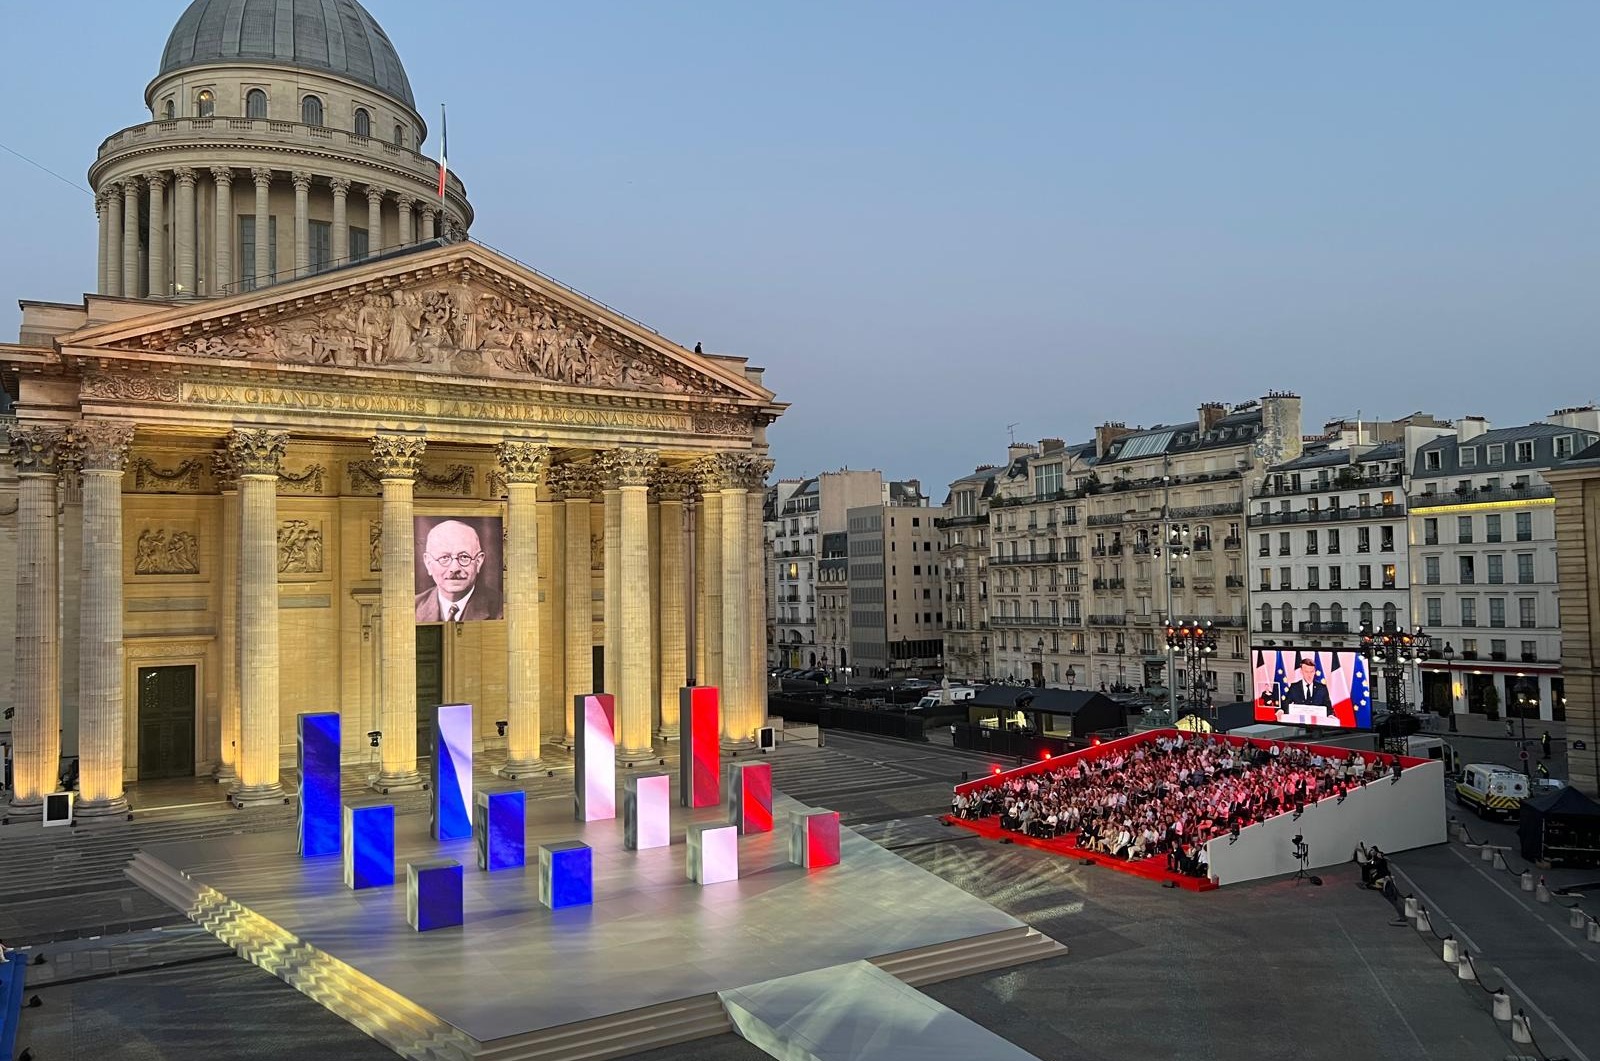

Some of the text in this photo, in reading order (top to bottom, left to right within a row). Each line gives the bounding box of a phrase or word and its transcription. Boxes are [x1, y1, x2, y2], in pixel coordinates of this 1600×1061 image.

[189, 384, 687, 430] AUX GRANDS HOMMES LA PATRIE RECONNAISSANTE
